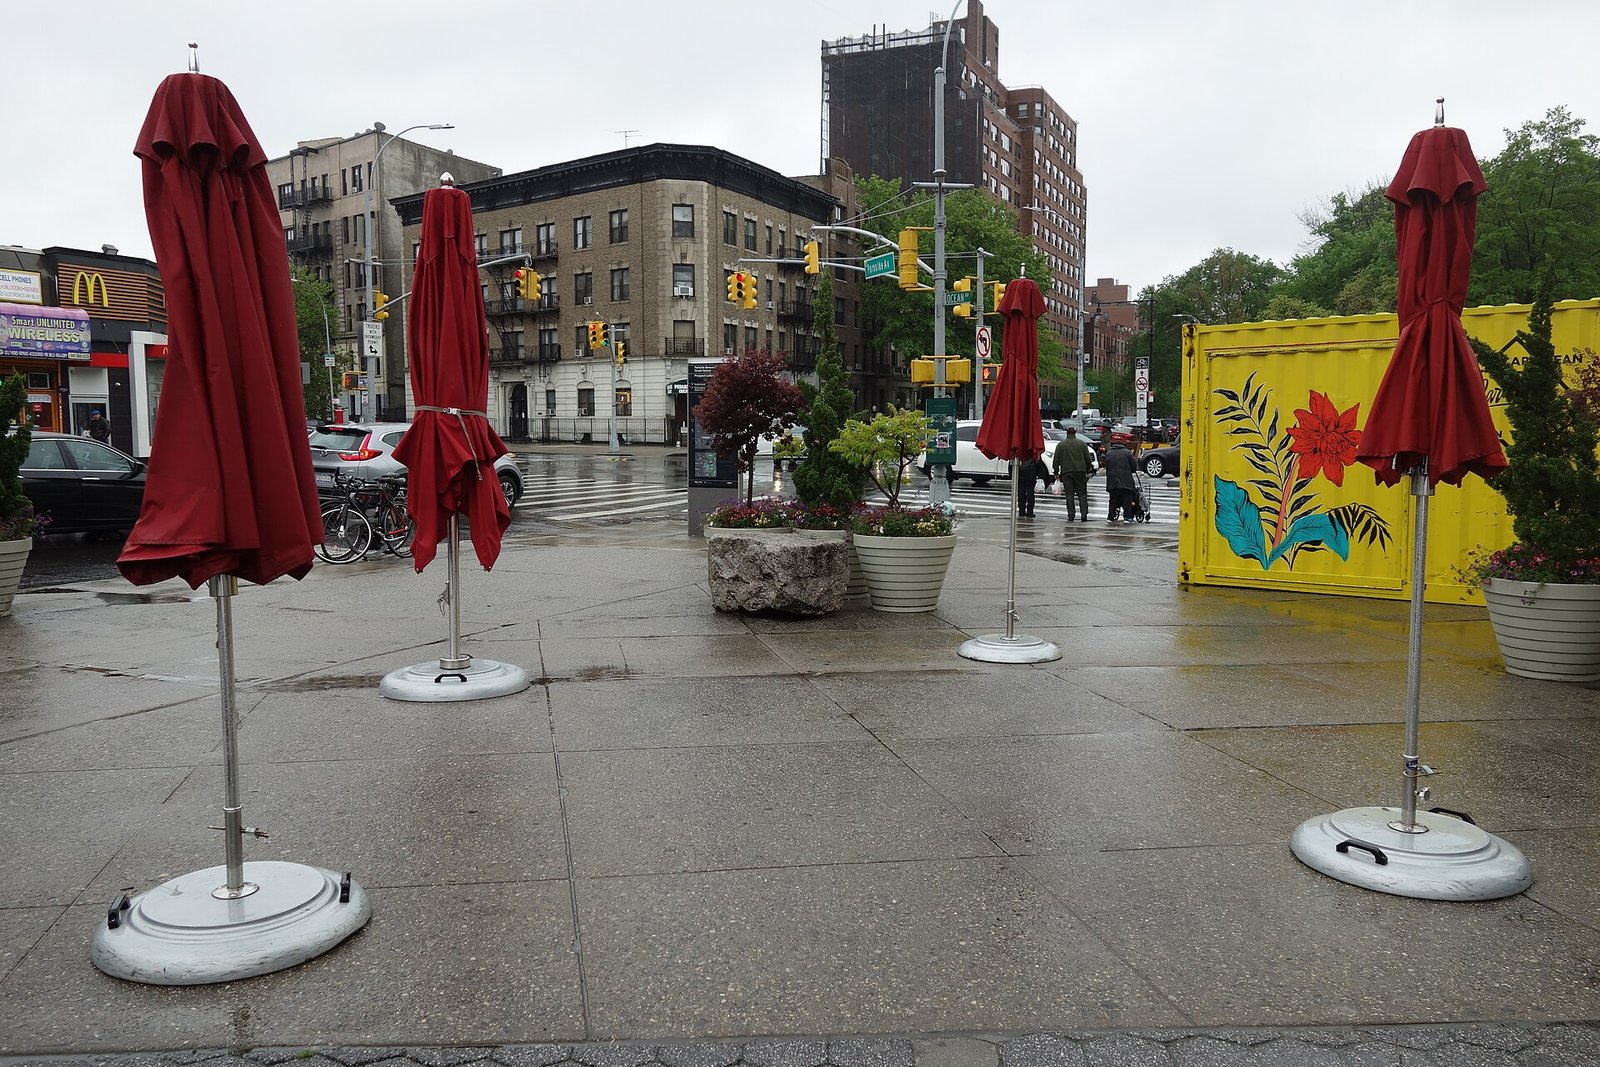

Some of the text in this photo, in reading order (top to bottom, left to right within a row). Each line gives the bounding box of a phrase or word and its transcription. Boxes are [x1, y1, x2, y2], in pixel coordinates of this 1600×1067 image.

[867, 260, 890, 273] Parkside Av
[0, 274, 32, 284] CELL PHONES
[947, 293, 964, 304] OCEAN
[11, 316, 76, 330] Smart UNLIMITED
[8, 327, 80, 343] WIRELESS
